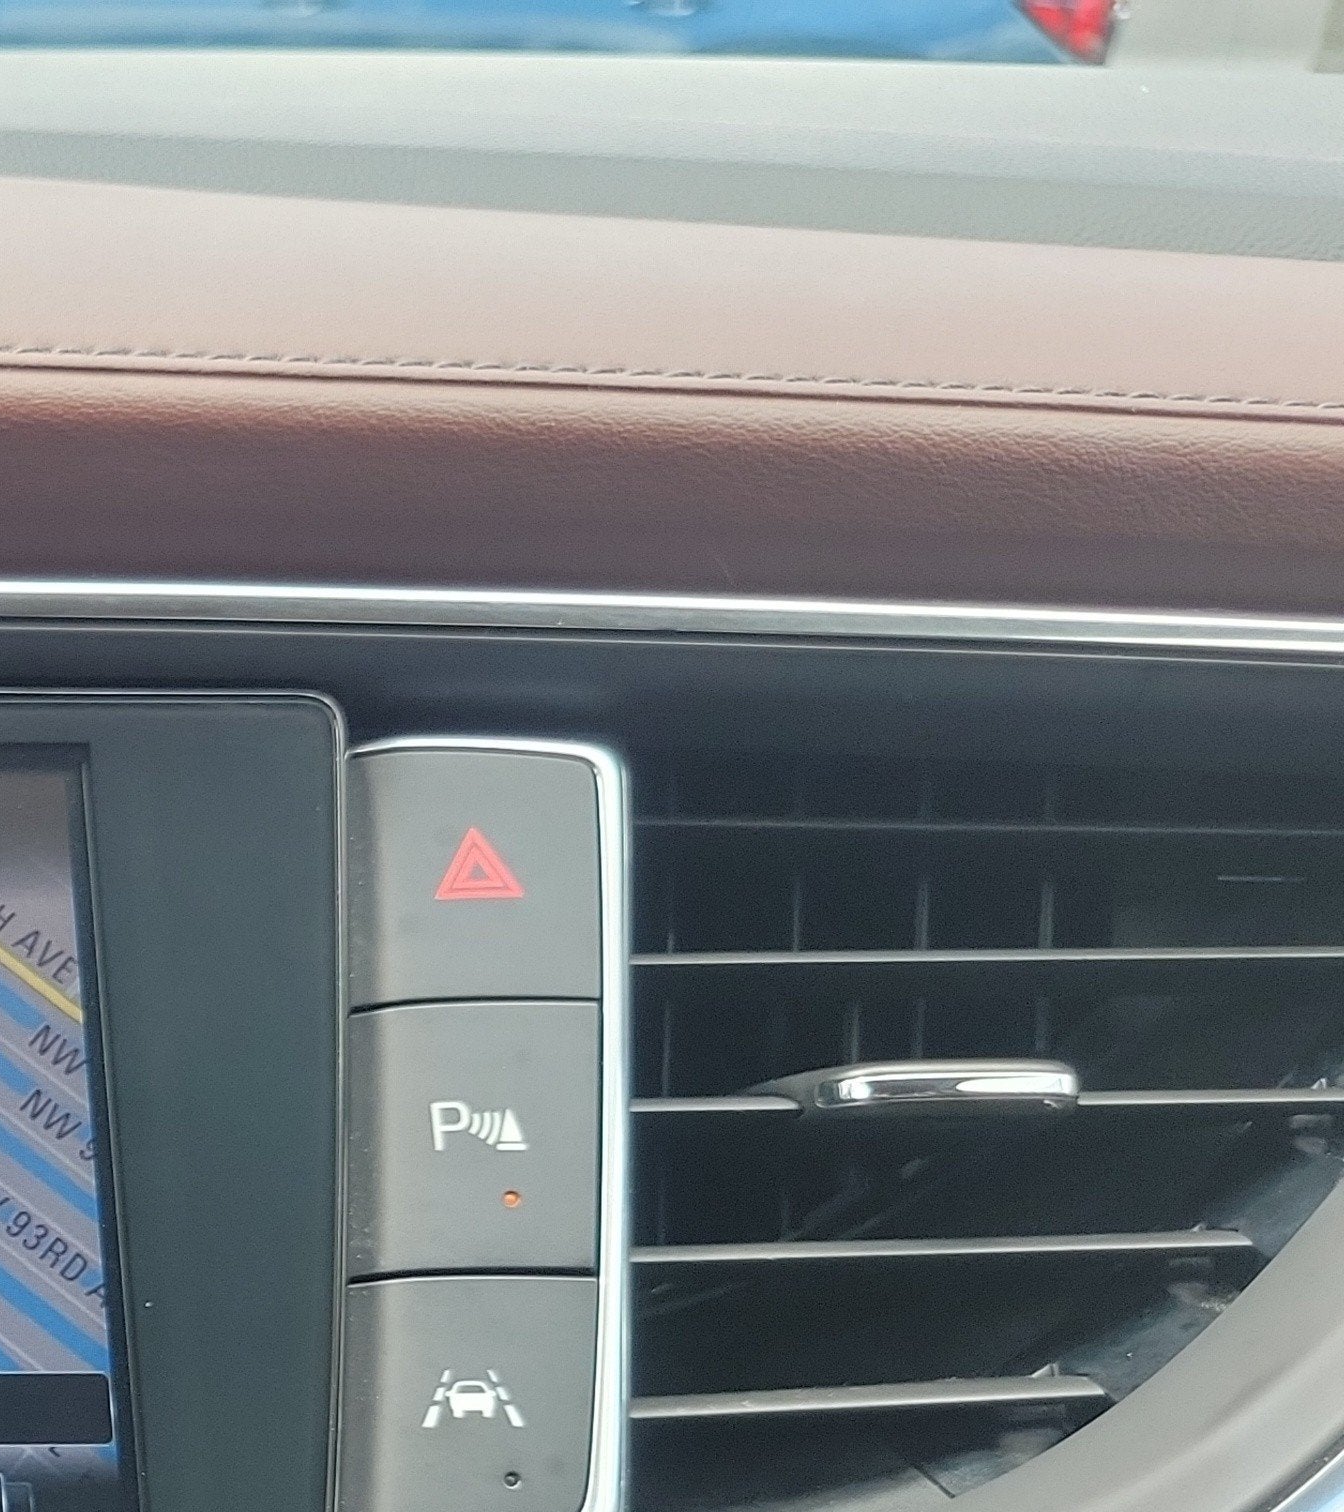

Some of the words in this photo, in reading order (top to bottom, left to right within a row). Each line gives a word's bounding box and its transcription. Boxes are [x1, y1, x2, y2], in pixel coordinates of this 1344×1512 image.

[12, 930, 79, 985] AVE
[28, 1024, 88, 1076] NW
[19, 1088, 83, 1141] NW
[5, 1210, 89, 1282] 93RD
